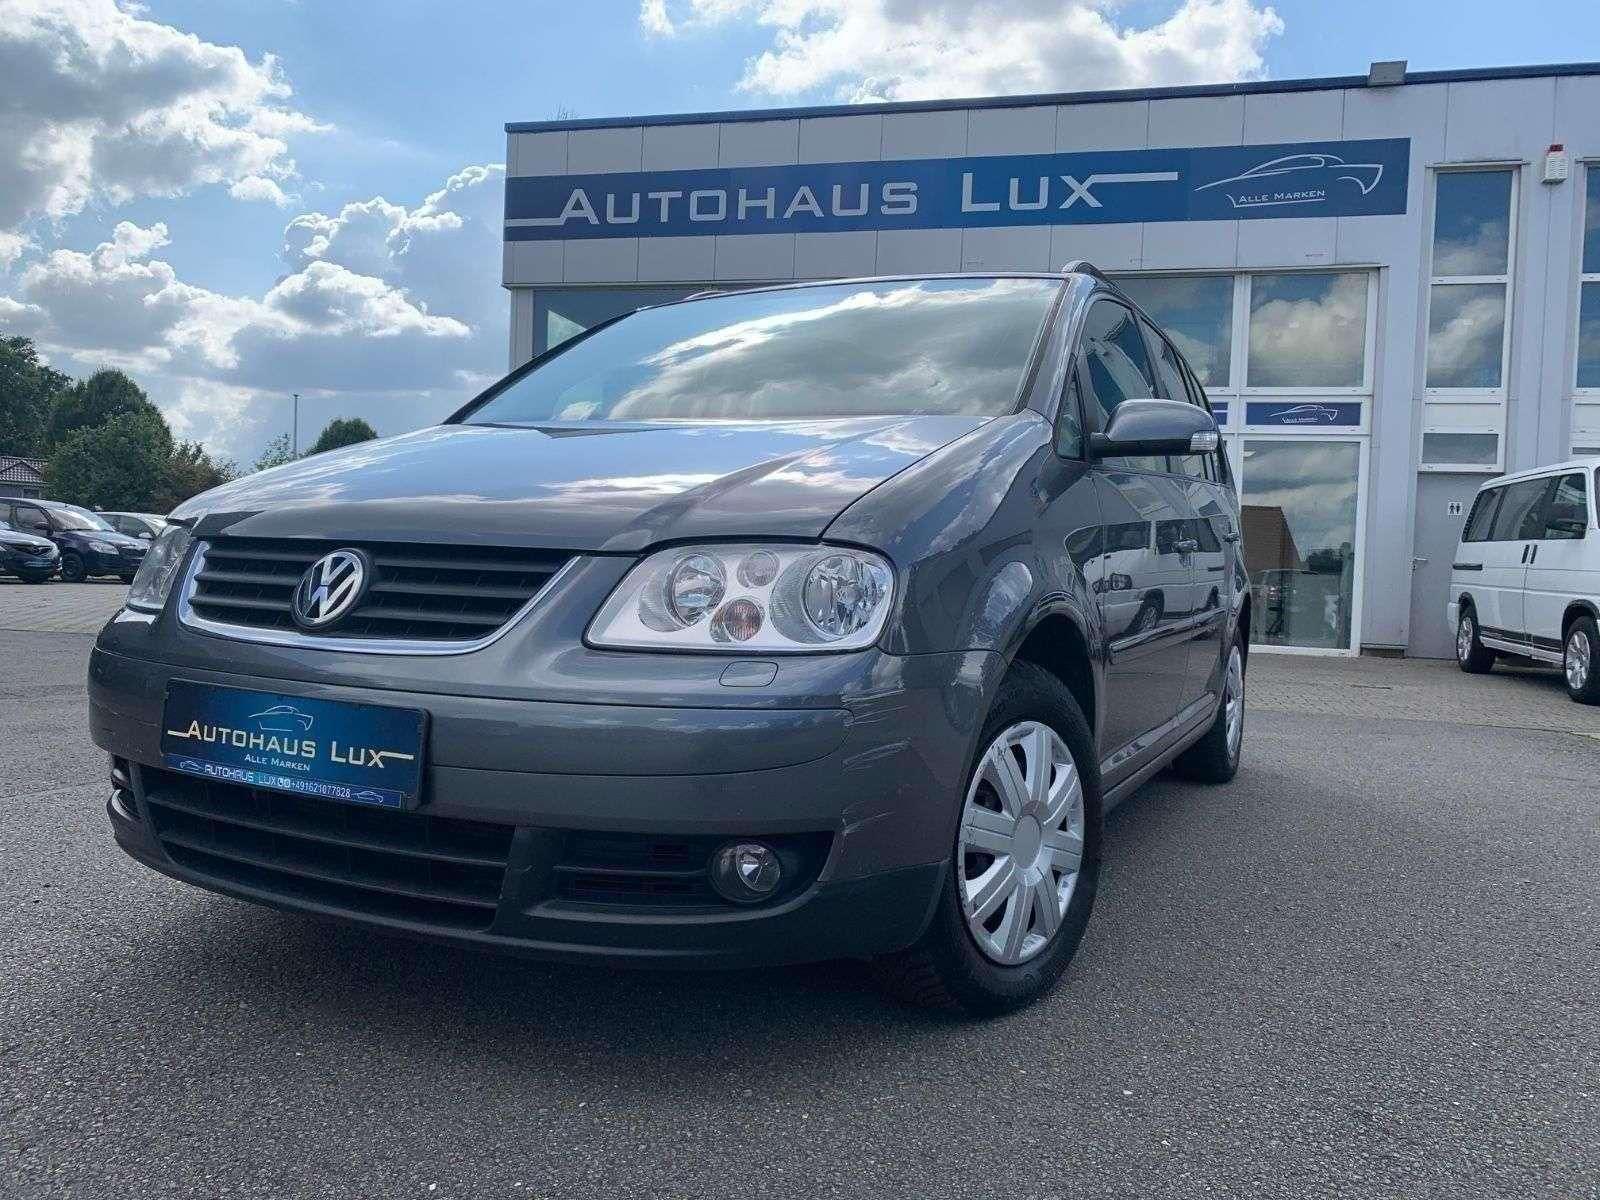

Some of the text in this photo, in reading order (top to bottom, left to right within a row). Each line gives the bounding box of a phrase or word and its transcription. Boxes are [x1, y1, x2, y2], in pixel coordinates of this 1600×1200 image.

[561, 172, 1104, 226] AUTOHAUS LUX
[1239, 190, 1326, 203] ALLE MARKEN
[187, 720, 386, 768] AUTOHAUS LUX
[244, 753, 310, 771] ALLE MARKEN
[204, 764, 254, 782] AUTOHAUS
[259, 774, 276, 785] LUX
